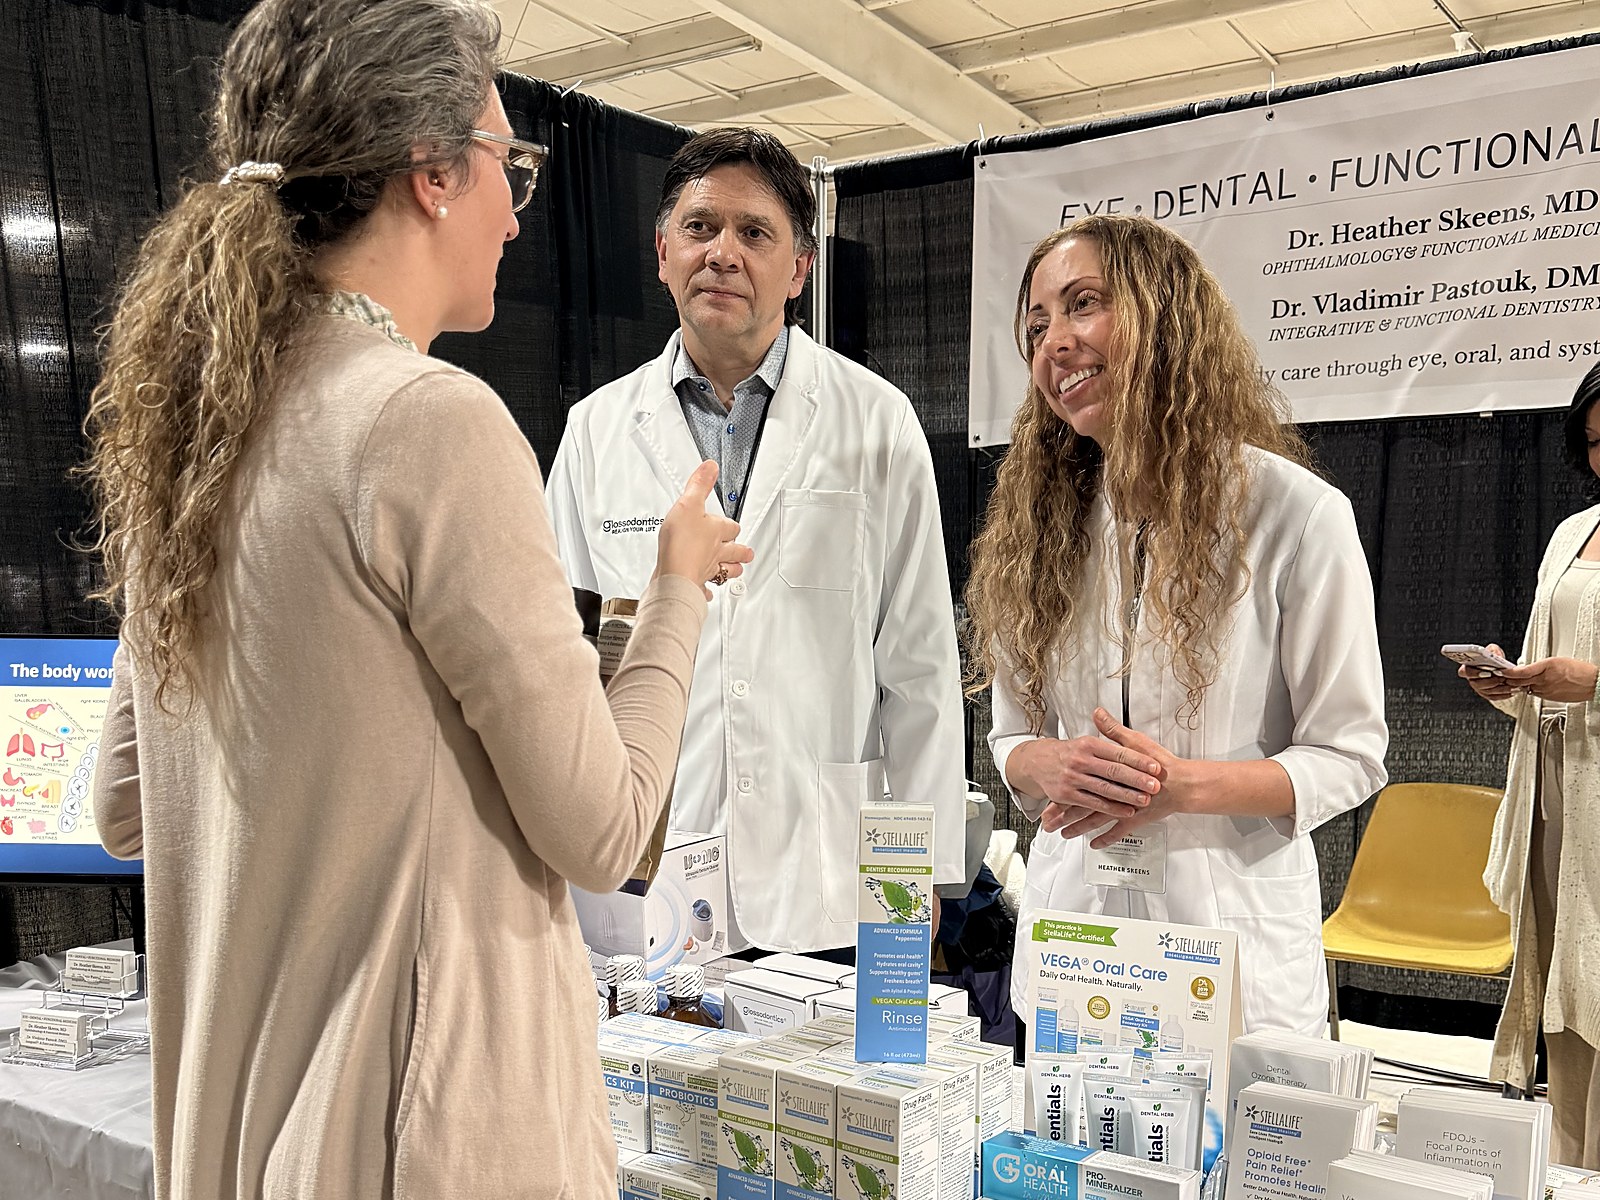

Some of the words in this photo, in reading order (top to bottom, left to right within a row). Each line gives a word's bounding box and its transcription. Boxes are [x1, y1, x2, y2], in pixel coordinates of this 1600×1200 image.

[1154, 168, 1296, 220] DENTAL
[1330, 121, 1600, 193] FUNCTIONAL
[1287, 229, 1324, 251] Dr.
[1330, 215, 1432, 246] Heather
[1438, 203, 1535, 234] Skeens,
[1543, 189, 1599, 216] MD
[1420, 230, 1528, 258] FUNCTIONAL
[1270, 299, 1306, 319] Dr.
[1312, 284, 1424, 315] Vladimir
[1429, 269, 1537, 306] Pastouk,
[1268, 320, 1375, 342] INTEGRATIVE
[1378, 318, 1392, 332] &
[1394, 304, 1498, 331] FUNCTIONAL
[1501, 297, 1600, 318] DENTISTRY
[1280, 363, 1321, 382] care
[1326, 353, 1402, 379] through
[1407, 352, 1447, 370] eye,
[1454, 343, 1503, 366] oral,
[1508, 340, 1551, 361] and
[9, 662, 39, 678] The
[42, 662, 81, 682] body
[866, 866, 886, 874] DENTIST
[887, 867, 927, 875] RECOMMENDED
[1098, 864, 1126, 873] HEATHER
[1126, 867, 1150, 876] SKEENS
[873, 927, 899, 935] ADVANCED
[899, 928, 923, 936] FORMULA
[1055, 922, 1077, 933] practice
[895, 935, 923, 944] Peppermint
[1076, 932, 1105, 943] Certified
[869, 969, 889, 977] Supports
[889, 969, 907, 977] healthy
[1039, 969, 1059, 982] Daily
[1059, 972, 1076, 982] Oral
[1077, 974, 1104, 987] Health.
[1106, 979, 1143, 991] Naturally.
[1093, 959, 1125, 976] Oral
[1129, 963, 1168, 982] Care
[882, 1010, 923, 1025] Rinse
[1251, 1070, 1276, 1084] Ozone
[1277, 1076, 1308, 1089] Therapy
[1266, 1064, 1291, 1077] Dental
[620, 1080, 635, 1091] KIT
[943, 1079, 956, 1093] Drug
[956, 1073, 971, 1085] Facts
[659, 1087, 715, 1107] PROBIOTICS
[903, 1098, 917, 1111] Drug
[918, 1092, 933, 1105] Facts
[722, 1111, 738, 1122] DENTIST
[738, 1115, 769, 1130] RECOMMENDED
[654, 1127, 680, 1138] PROBIOTIC
[780, 1125, 797, 1137] DENTIST
[797, 1130, 829, 1145] RECOMMENDED
[1442, 1131, 1477, 1145] FDOJs
[1247, 1148, 1282, 1165] Opioid
[1426, 1140, 1453, 1153] Focal
[1456, 1145, 1488, 1158] Points
[1490, 1149, 1502, 1160] of
[1246, 1159, 1268, 1173] Pain
[1424, 1152, 1490, 1169] Inflammation
[1492, 1161, 1502, 1171] in
[727, 1172, 748, 1185] ADVANCED
[747, 1177, 767, 1189] FORMULA
[1023, 1163, 1068, 1185] ORAL
[1085, 1170, 1106, 1181] PRO-
[1244, 1170, 1292, 1190] Promotes
[1023, 1177, 1069, 1198] HEALTH
[1085, 1178, 1143, 1198] MINERALIZER
[1257, 1186, 1270, 1196] Daily
[1270, 1189, 1281, 1197] Oral
